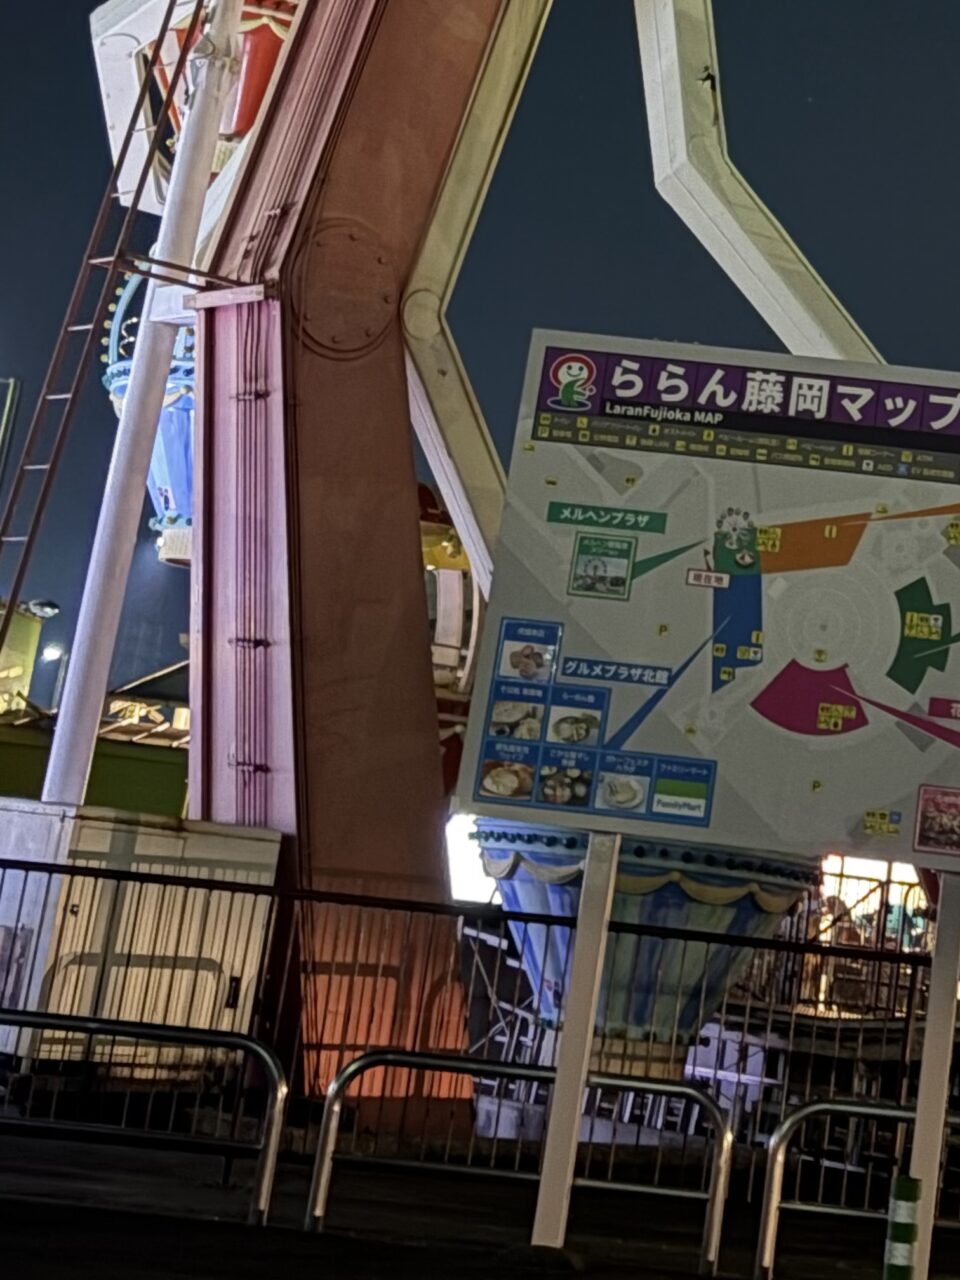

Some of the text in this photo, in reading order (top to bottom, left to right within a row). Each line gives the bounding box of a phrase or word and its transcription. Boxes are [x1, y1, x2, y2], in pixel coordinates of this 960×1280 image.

[605, 401, 724, 425] LaranFujioka MAP
[560, 507, 650, 527] メルヘンプラザ
[564, 661, 670, 684] グルメプラザ北館
